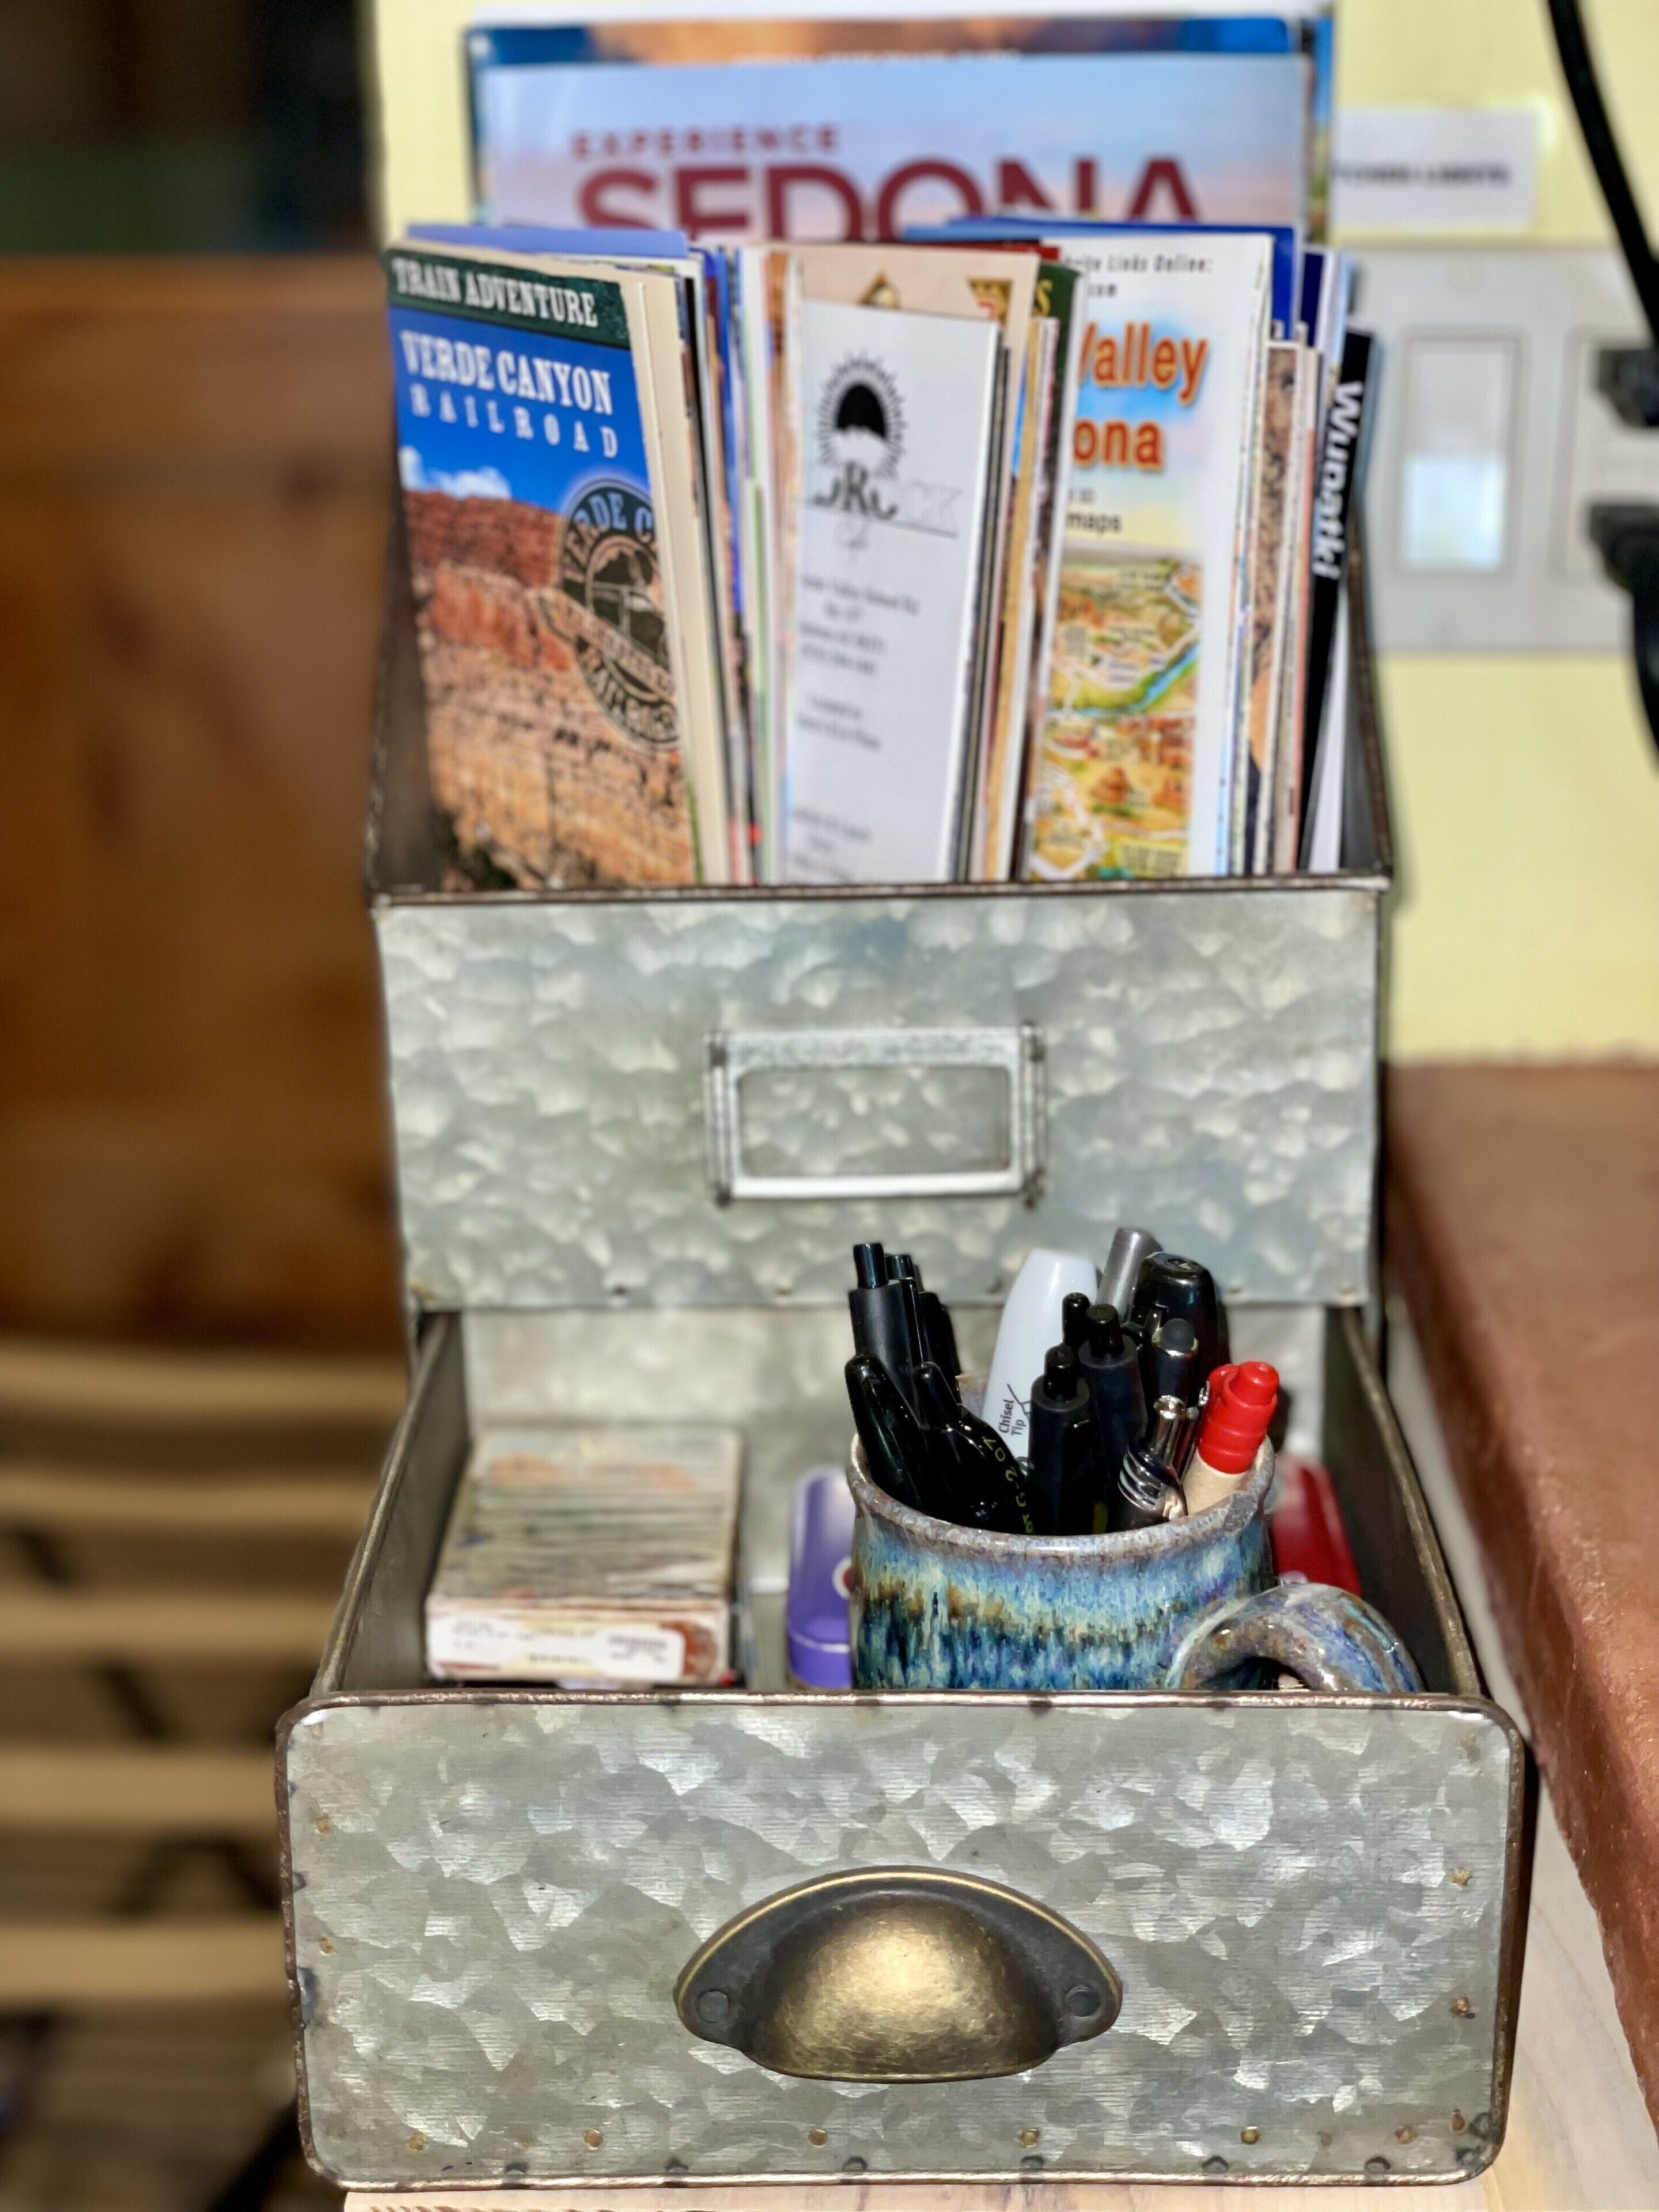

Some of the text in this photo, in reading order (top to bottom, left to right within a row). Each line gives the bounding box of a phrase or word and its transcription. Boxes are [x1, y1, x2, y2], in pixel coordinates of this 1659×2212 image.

[571, 123, 840, 158] EXPERIENCE
[392, 257, 599, 327] TRAIN ADVENTURE
[400, 329, 613, 416] VERDE CANYON
[410, 382, 619, 459] RAILROAD
[1310, 380, 1365, 579] Wupatki
[998, 1398, 1015, 1434] Chisel
[1010, 1418, 1028, 1436] Tip
